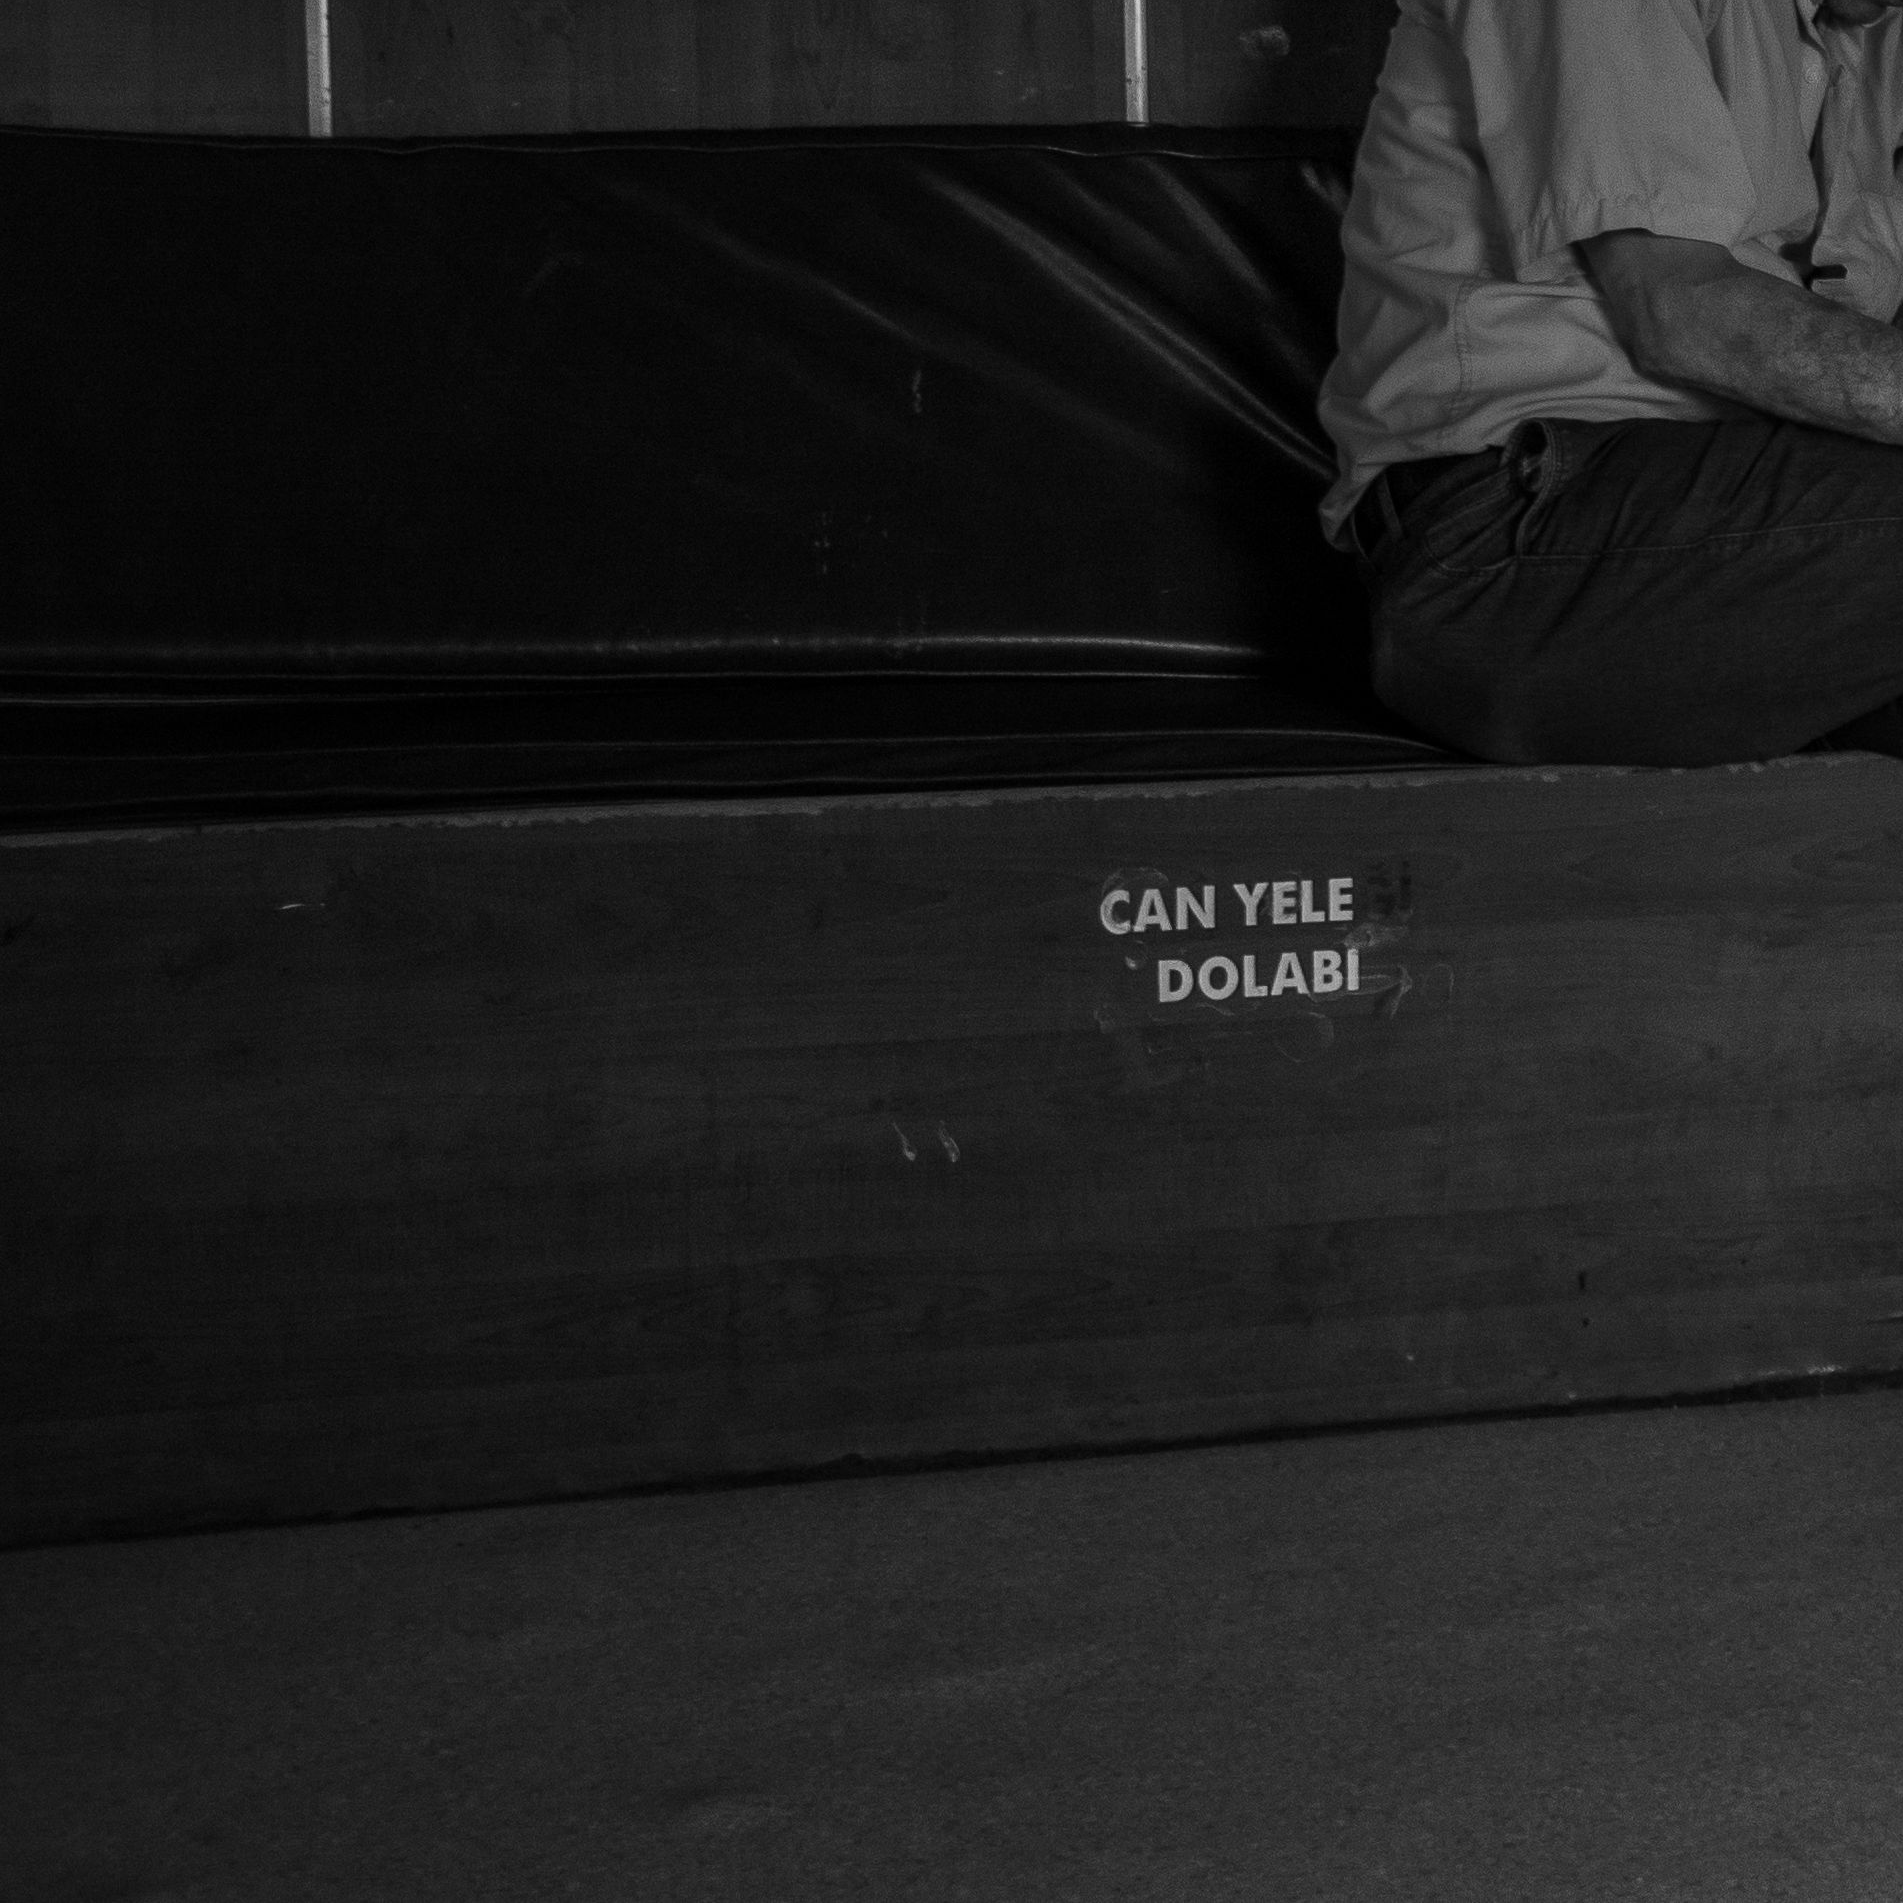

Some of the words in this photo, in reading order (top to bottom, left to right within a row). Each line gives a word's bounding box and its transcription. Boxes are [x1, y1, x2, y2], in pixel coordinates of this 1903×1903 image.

[1100, 885, 1215, 934] CAN
[1233, 878, 1353, 926] YELE
[1158, 947, 1359, 1002] DOLABI
